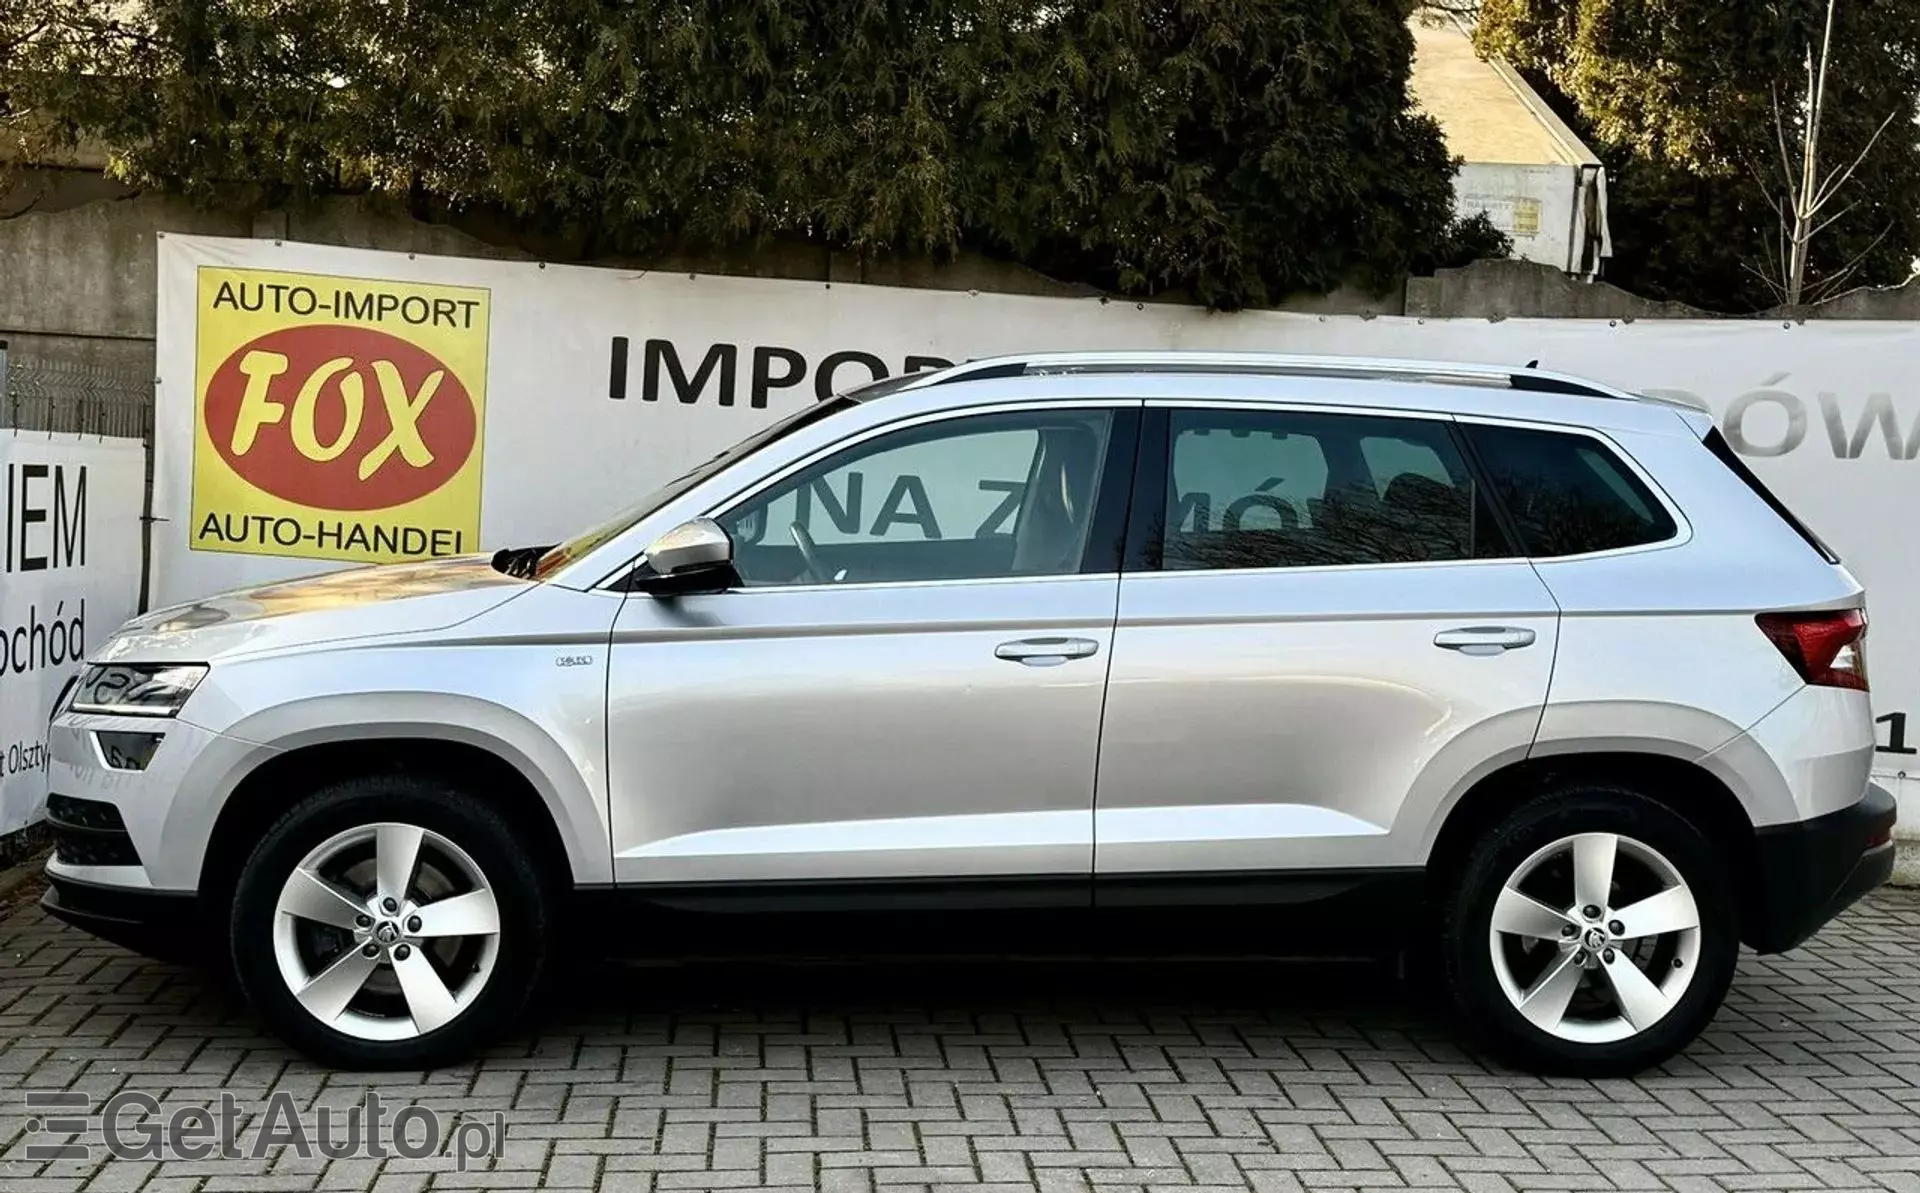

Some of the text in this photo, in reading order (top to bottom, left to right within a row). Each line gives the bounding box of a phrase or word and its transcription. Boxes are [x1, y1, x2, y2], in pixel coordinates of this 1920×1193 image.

[212, 280, 480, 329] AUTO-IMPORT
[608, 335, 973, 409] IMPO
[230, 349, 445, 482] FOX
[795, 471, 943, 540] NA
[8, 740, 48, 775] Olszty
